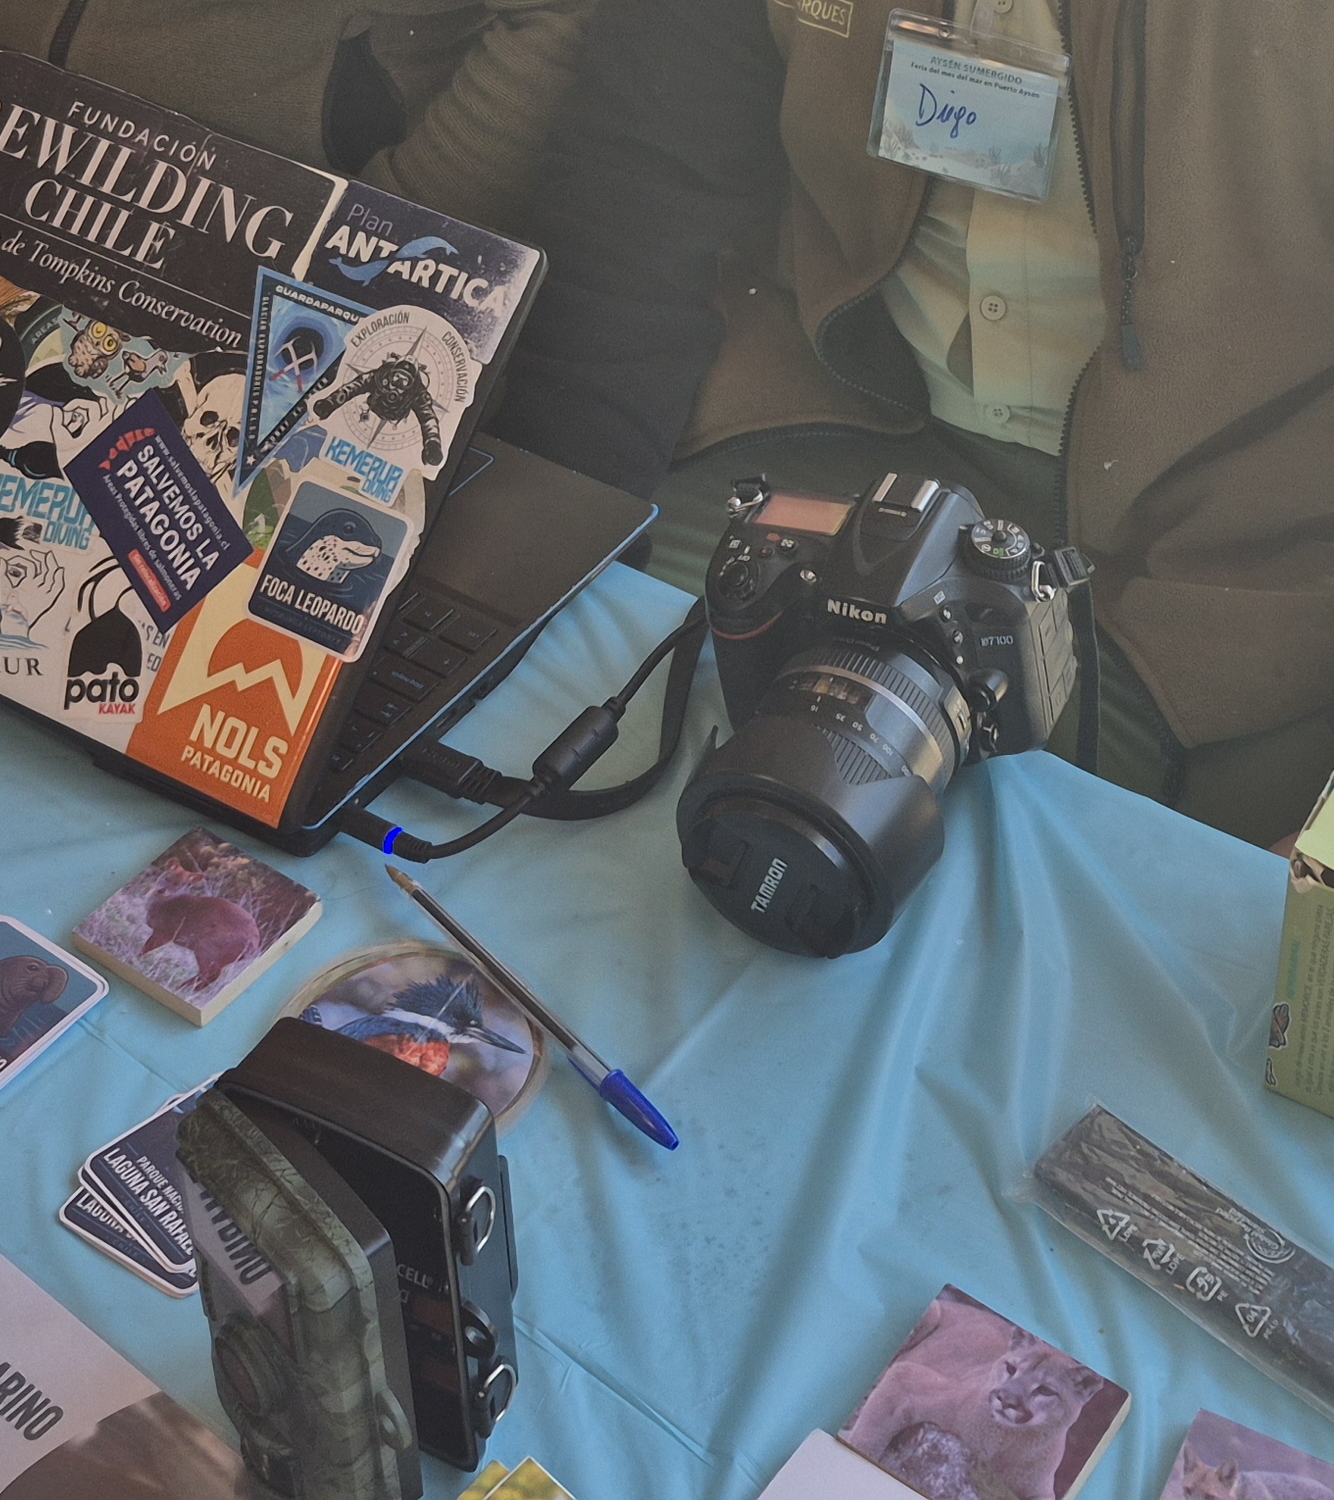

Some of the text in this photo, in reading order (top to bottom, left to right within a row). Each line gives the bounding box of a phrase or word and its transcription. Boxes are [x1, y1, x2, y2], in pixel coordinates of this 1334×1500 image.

[963, 63, 1022, 85] SUMERGIDO
[994, 82, 1017, 93] Puerto
[68, 101, 217, 171] FUNDACIÓN
[24, 178, 176, 270] CHILE
[346, 203, 393, 236] Plan
[2, 230, 26, 255] de
[27, 240, 116, 294] Tompkins
[118, 279, 244, 348] Conservation
[275, 284, 367, 325] GUARDAPARQU
[350, 312, 411, 348] EXPLORACIÓN
[441, 330, 471, 403] CONSERVACIÓN
[43, 520, 91, 551] DIVING
[116, 460, 202, 591] PATAGONIA
[136, 444, 220, 571] SALVEMOS LA
[115, 492, 140, 528] Protegidas
[136, 525, 151, 549] libres
[148, 548, 158, 559] de
[153, 557, 182, 601] salmoneras
[259, 573, 297, 607] FOCA
[294, 589, 366, 636] LEOPARDO
[827, 598, 887, 624] Nikon
[64, 670, 139, 710] pato
[98, 703, 137, 715] KAYAK
[188, 703, 289, 781] NOLS
[181, 744, 271, 803] PATAGONIA
[750, 856, 788, 914] TAMRON
[136, 1155, 168, 1189] PARQUE
[103, 1148, 194, 1256] LAGUNA SAN RAFAEL
